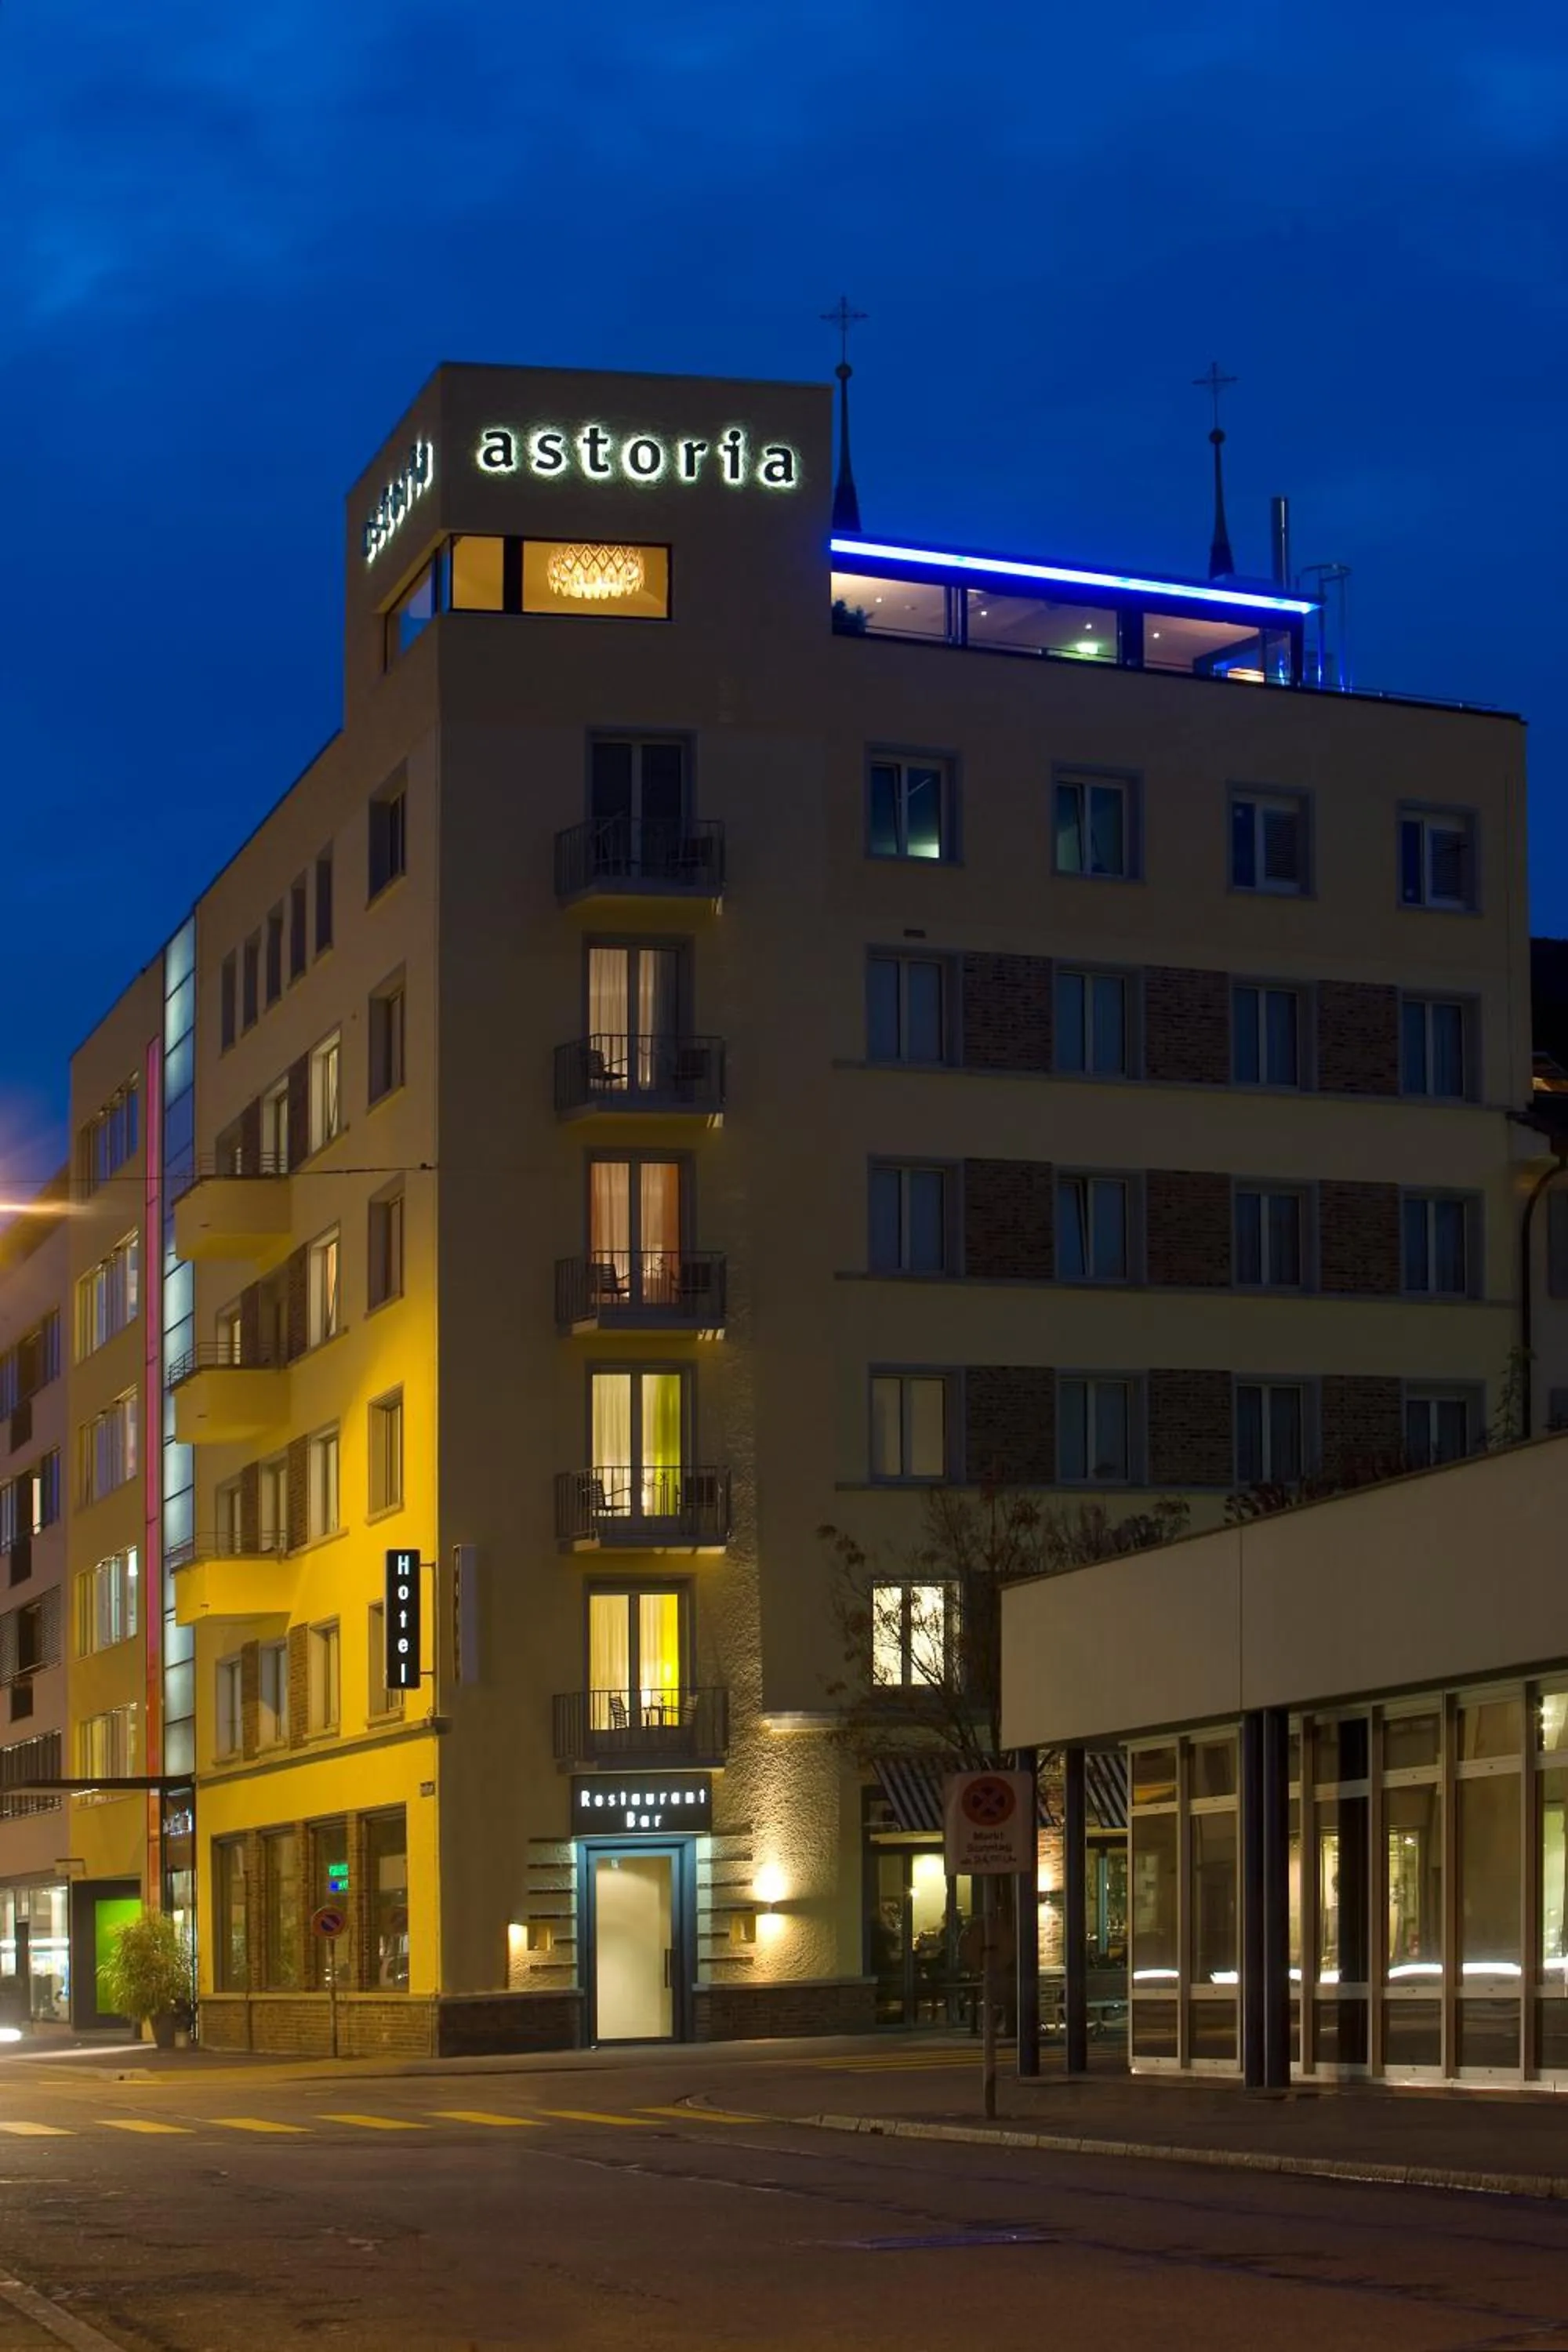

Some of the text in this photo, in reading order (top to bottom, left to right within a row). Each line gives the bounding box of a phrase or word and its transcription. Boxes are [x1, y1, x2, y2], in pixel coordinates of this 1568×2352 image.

[481, 426, 794, 484] astoria
[397, 1555, 410, 1683] Hotel
[580, 1788, 705, 1807] Restaurant
[626, 1810, 662, 1828] Bar
